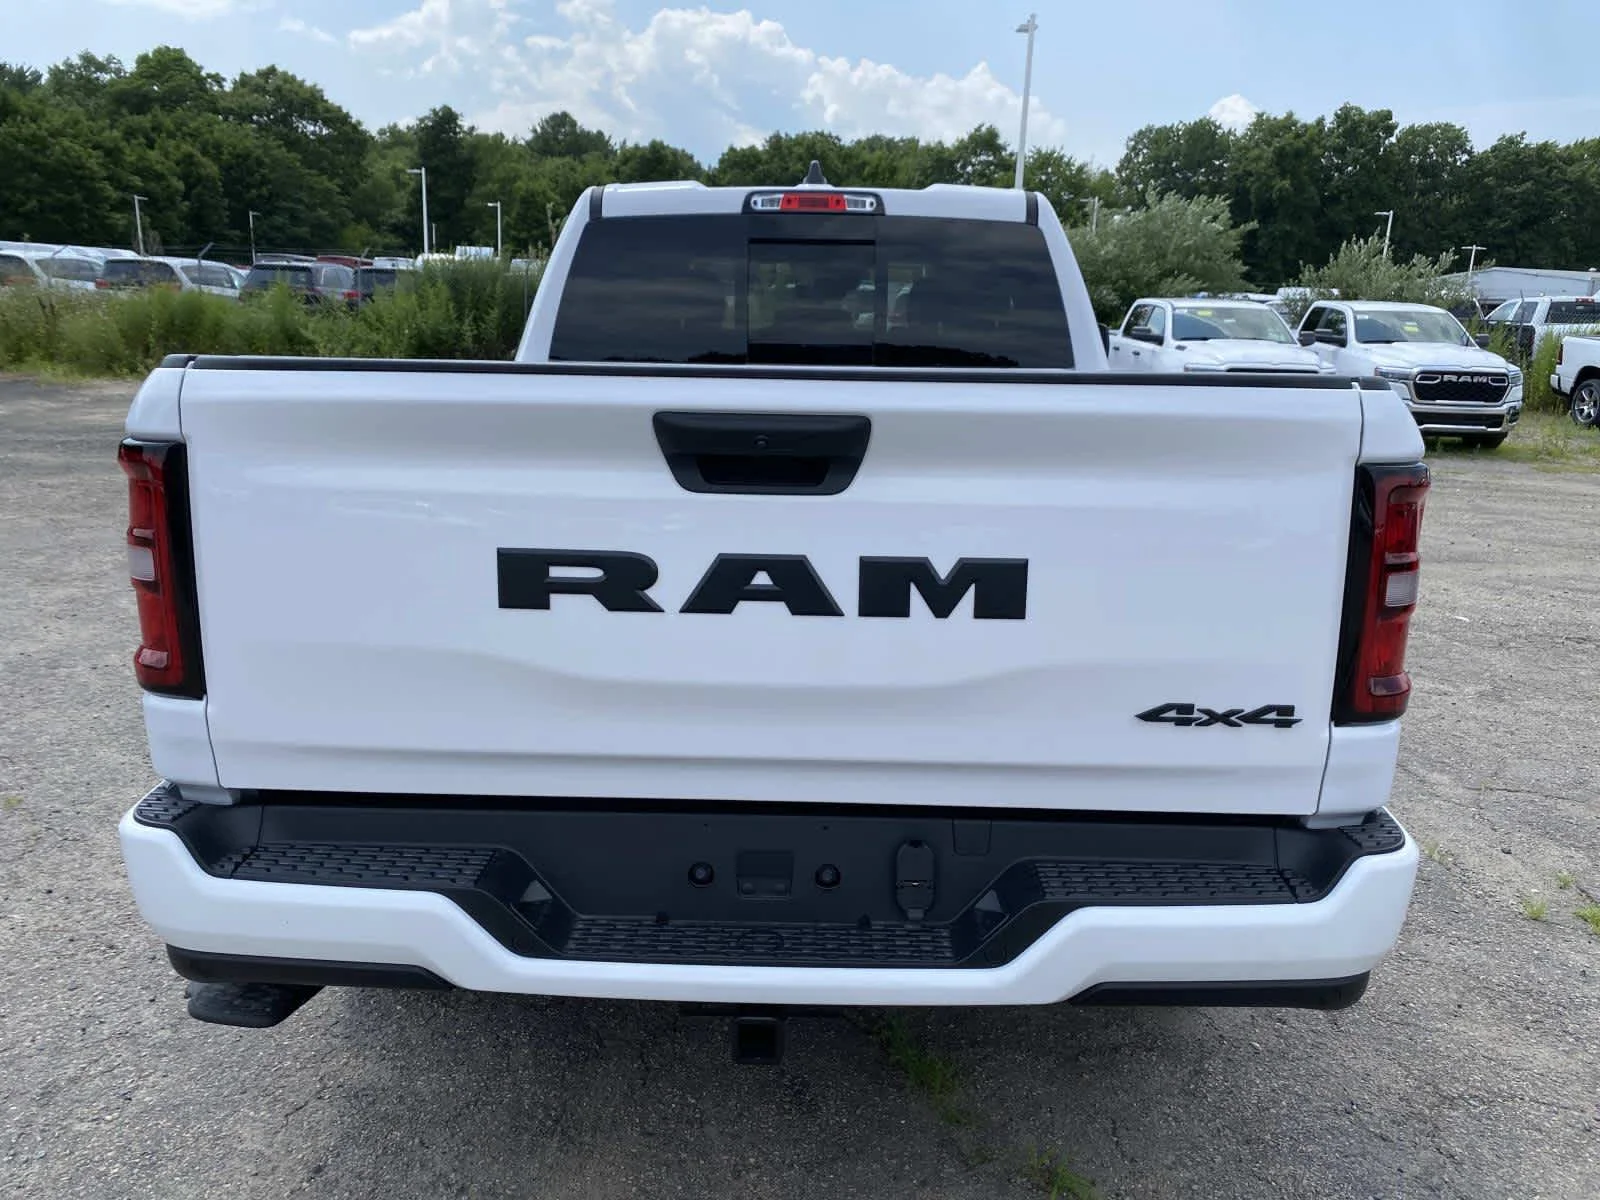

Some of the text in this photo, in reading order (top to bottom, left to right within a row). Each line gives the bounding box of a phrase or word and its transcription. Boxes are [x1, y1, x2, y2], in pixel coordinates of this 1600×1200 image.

[1443, 374, 1488, 383] RAM
[497, 548, 1029, 619] RAM
[1135, 702, 1302, 728] 4x4
